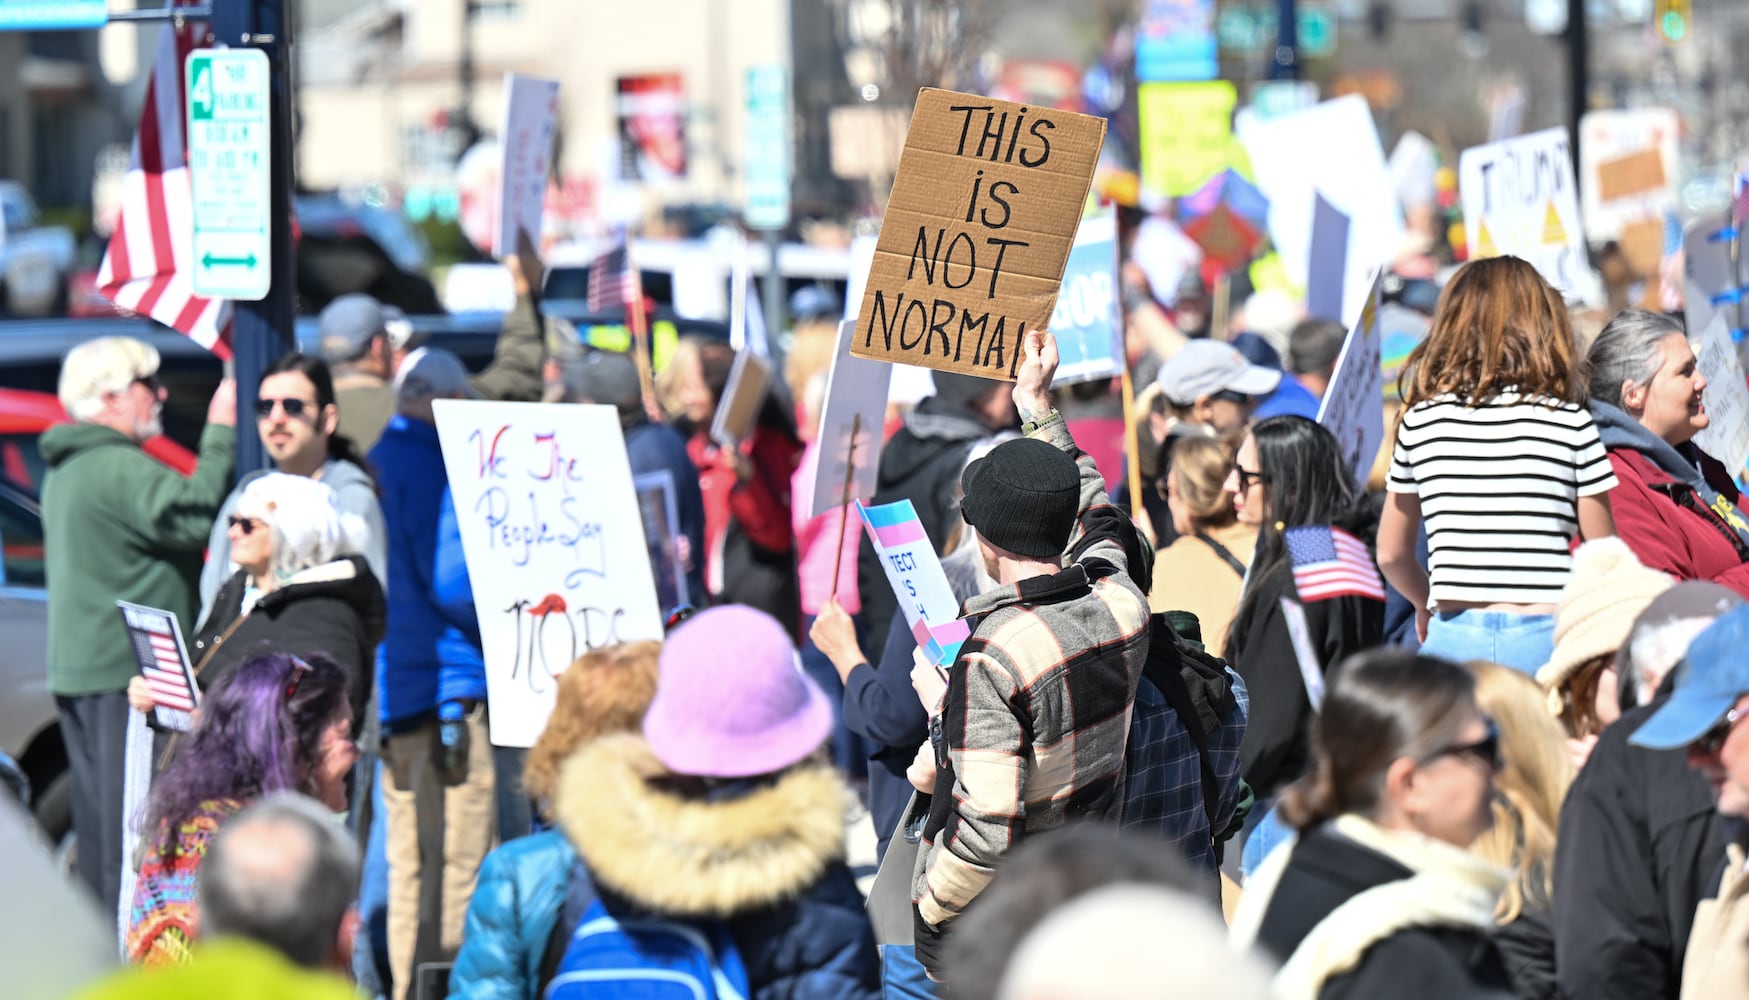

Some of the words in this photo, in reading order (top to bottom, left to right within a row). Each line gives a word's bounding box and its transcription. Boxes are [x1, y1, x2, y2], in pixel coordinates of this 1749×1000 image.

[192, 65, 213, 114] 4
[907, 226, 1030, 299] NOT
[866, 290, 1026, 379] NORMAL
[468, 423, 512, 479] We
[527, 430, 583, 481] The
[474, 486, 555, 566] People
[557, 497, 606, 589] Say
